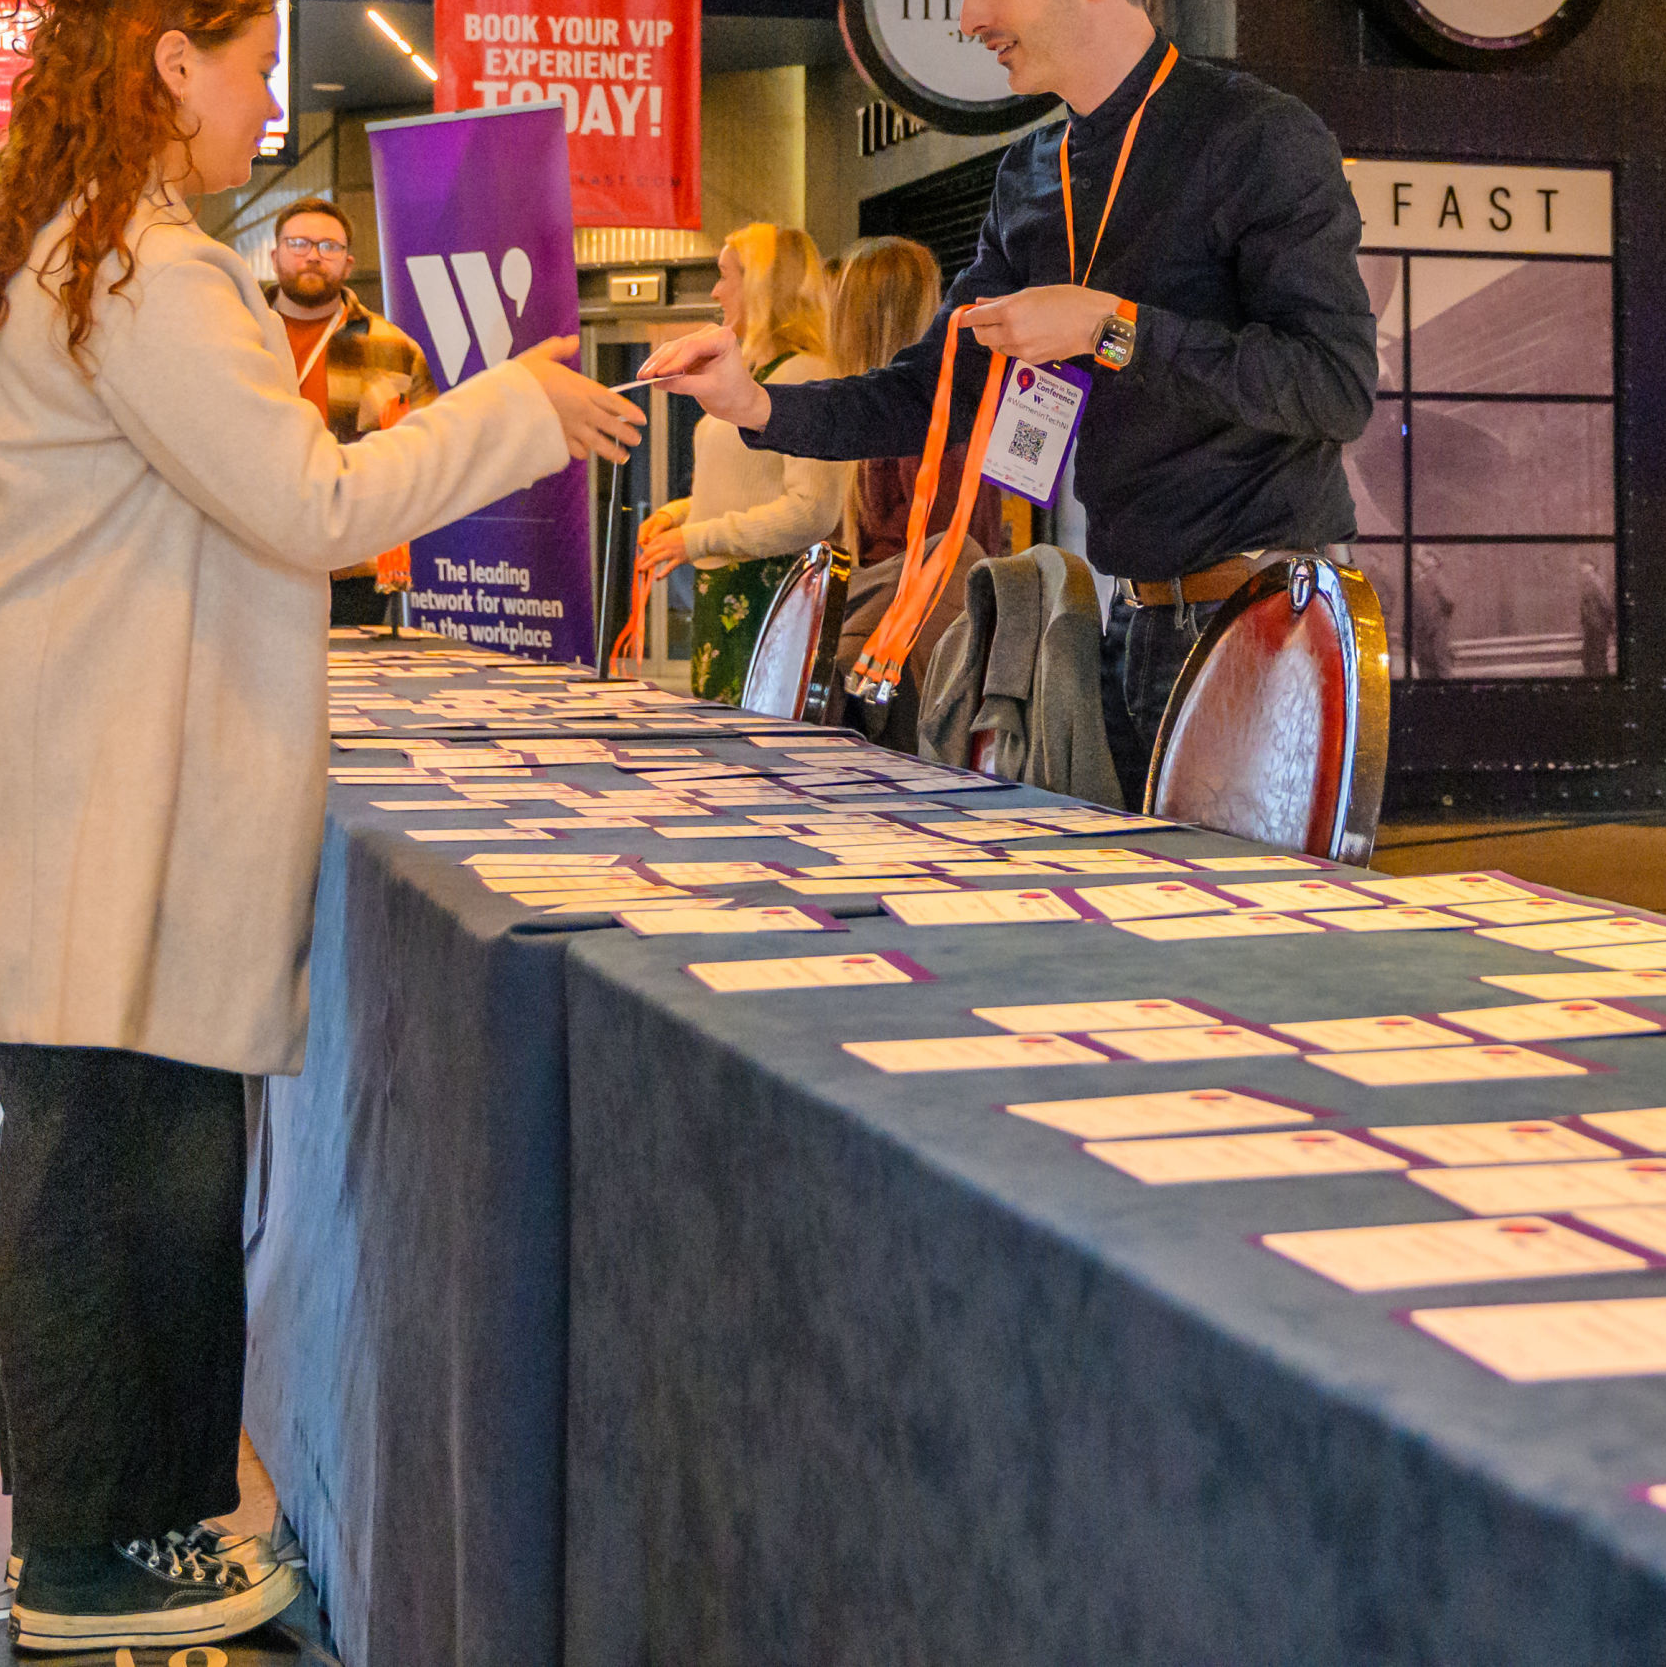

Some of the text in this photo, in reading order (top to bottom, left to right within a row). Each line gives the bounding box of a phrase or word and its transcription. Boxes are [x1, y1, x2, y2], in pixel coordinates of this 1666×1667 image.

[464, 13, 674, 47] BOOK YOUR VIP
[485, 47, 653, 81] EXPERIENCE
[1347, 180, 1560, 233] FAST
[1036, 382, 1075, 406] Conference
[434, 557, 531, 593] The leading
[410, 587, 564, 619] network for women
[420, 615, 553, 652] in the workplace
